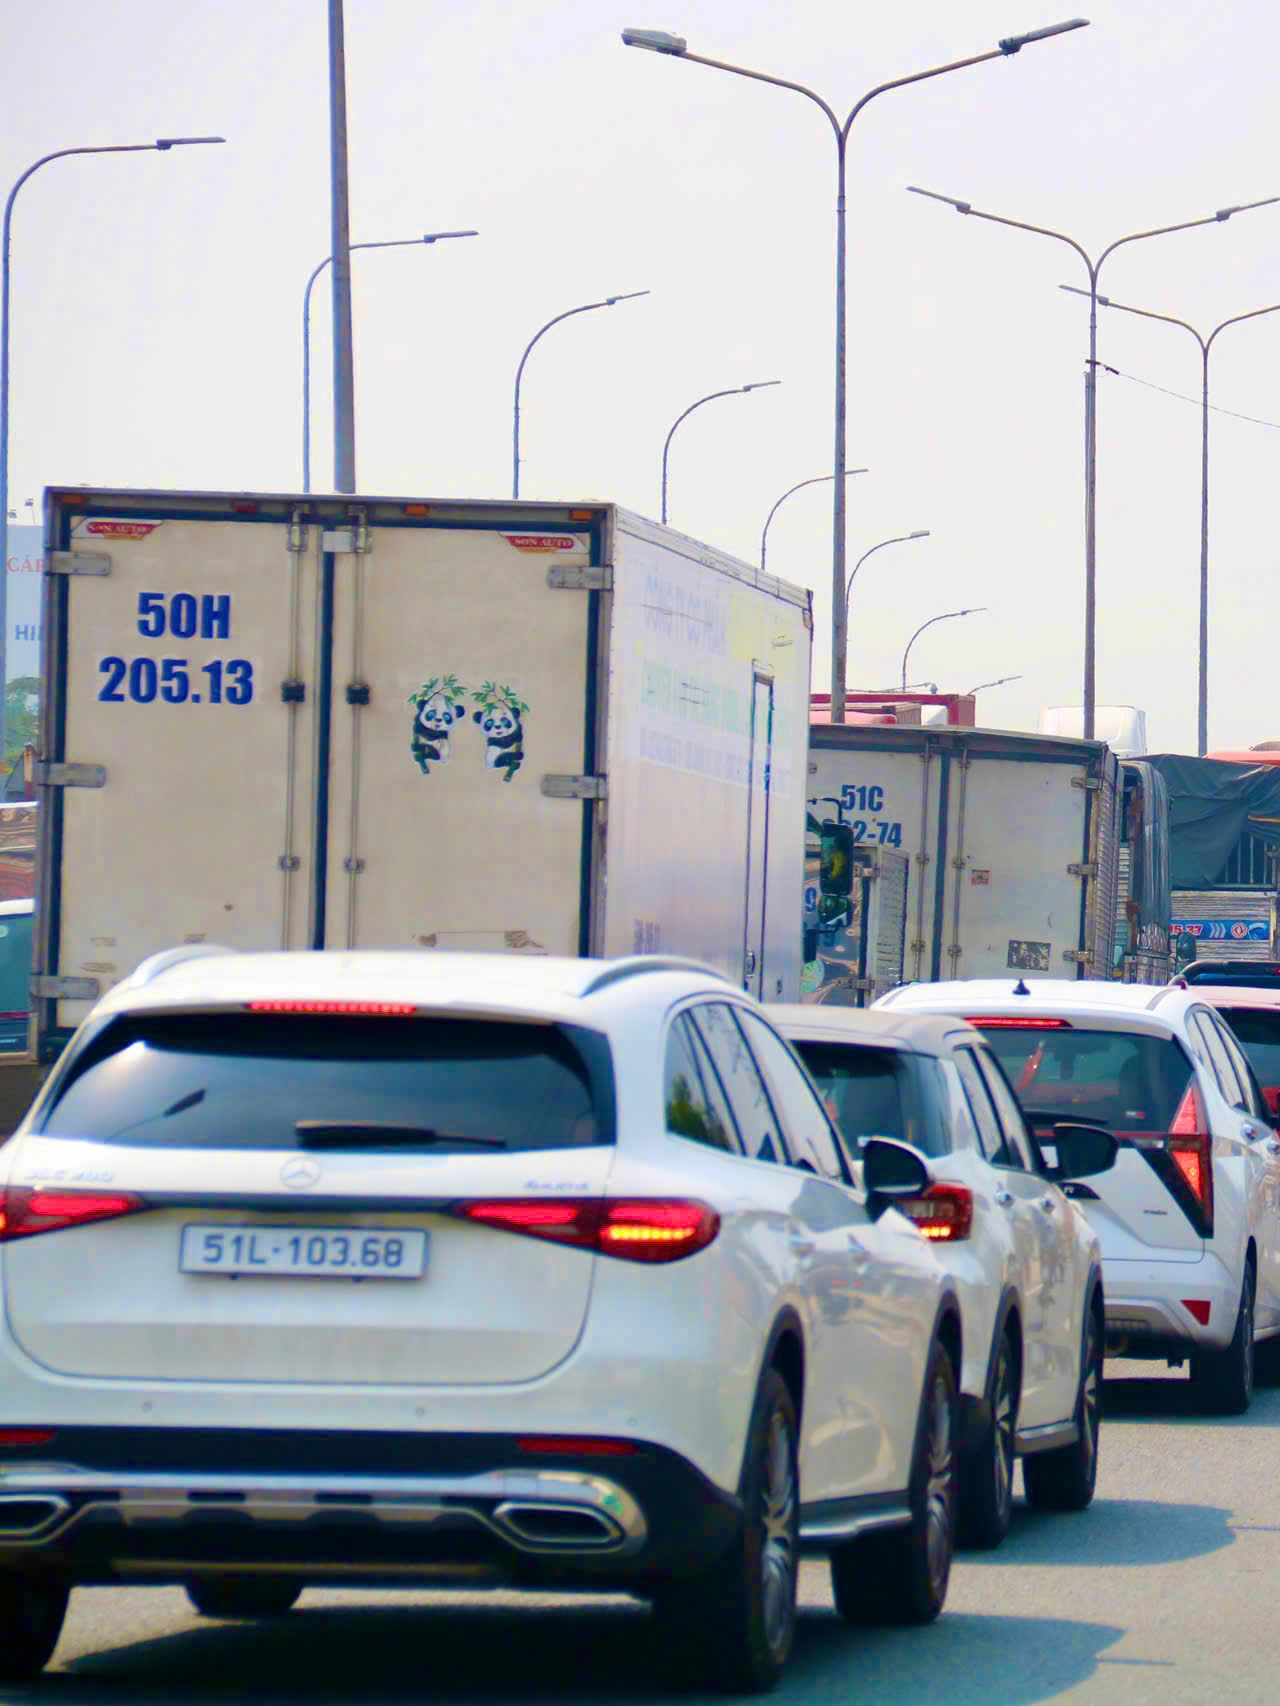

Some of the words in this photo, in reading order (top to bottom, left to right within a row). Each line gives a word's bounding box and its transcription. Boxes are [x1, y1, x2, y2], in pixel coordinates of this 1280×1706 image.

[137, 592, 231, 639] 50H
[98, 656, 254, 704] 205.13
[840, 784, 884, 812] 51C
[203, 1233, 404, 1268] 51L-103.68
